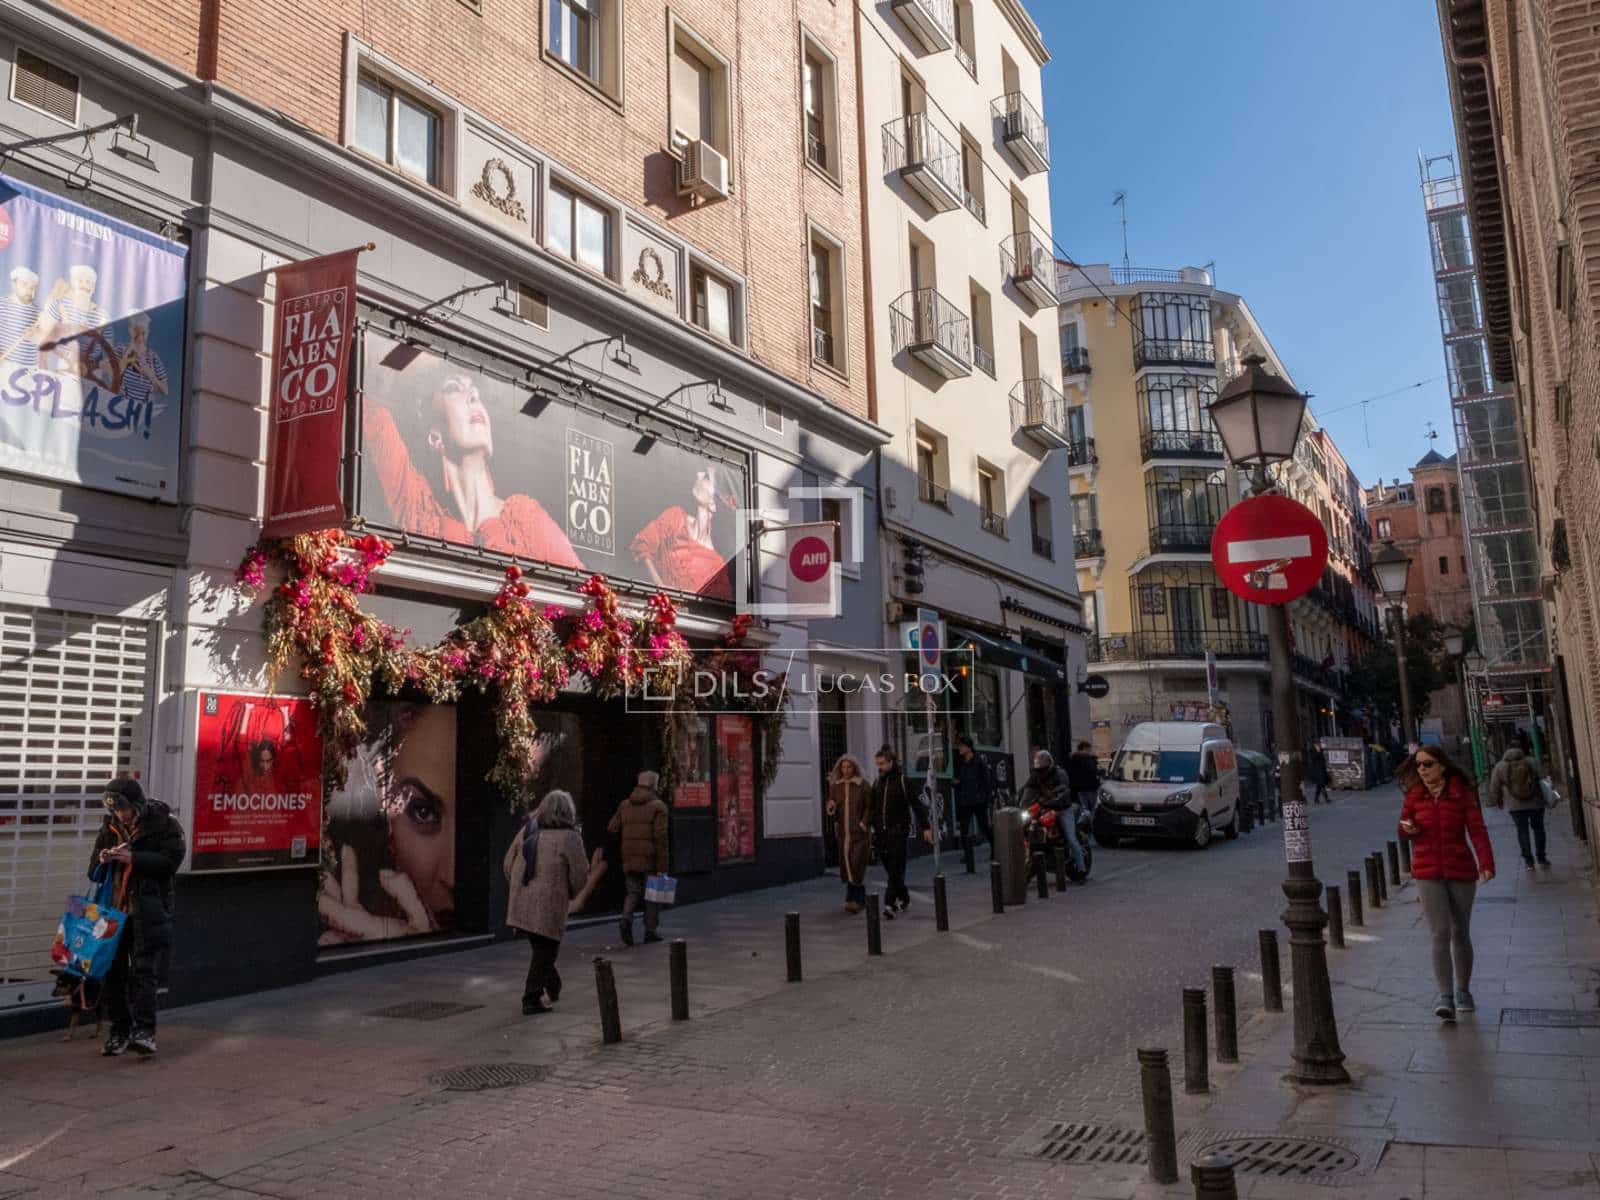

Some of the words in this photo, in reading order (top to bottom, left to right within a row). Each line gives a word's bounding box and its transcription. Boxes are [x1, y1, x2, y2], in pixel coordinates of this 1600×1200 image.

[284, 305, 342, 347] FLA
[282, 339, 341, 370] MEN
[281, 362, 337, 403] CO
[1, 368, 154, 440] SPLASH!
[280, 396, 334, 419] MADRID
[569, 445, 611, 485] FLA
[569, 478, 611, 505] MEN
[569, 500, 612, 535] CO
